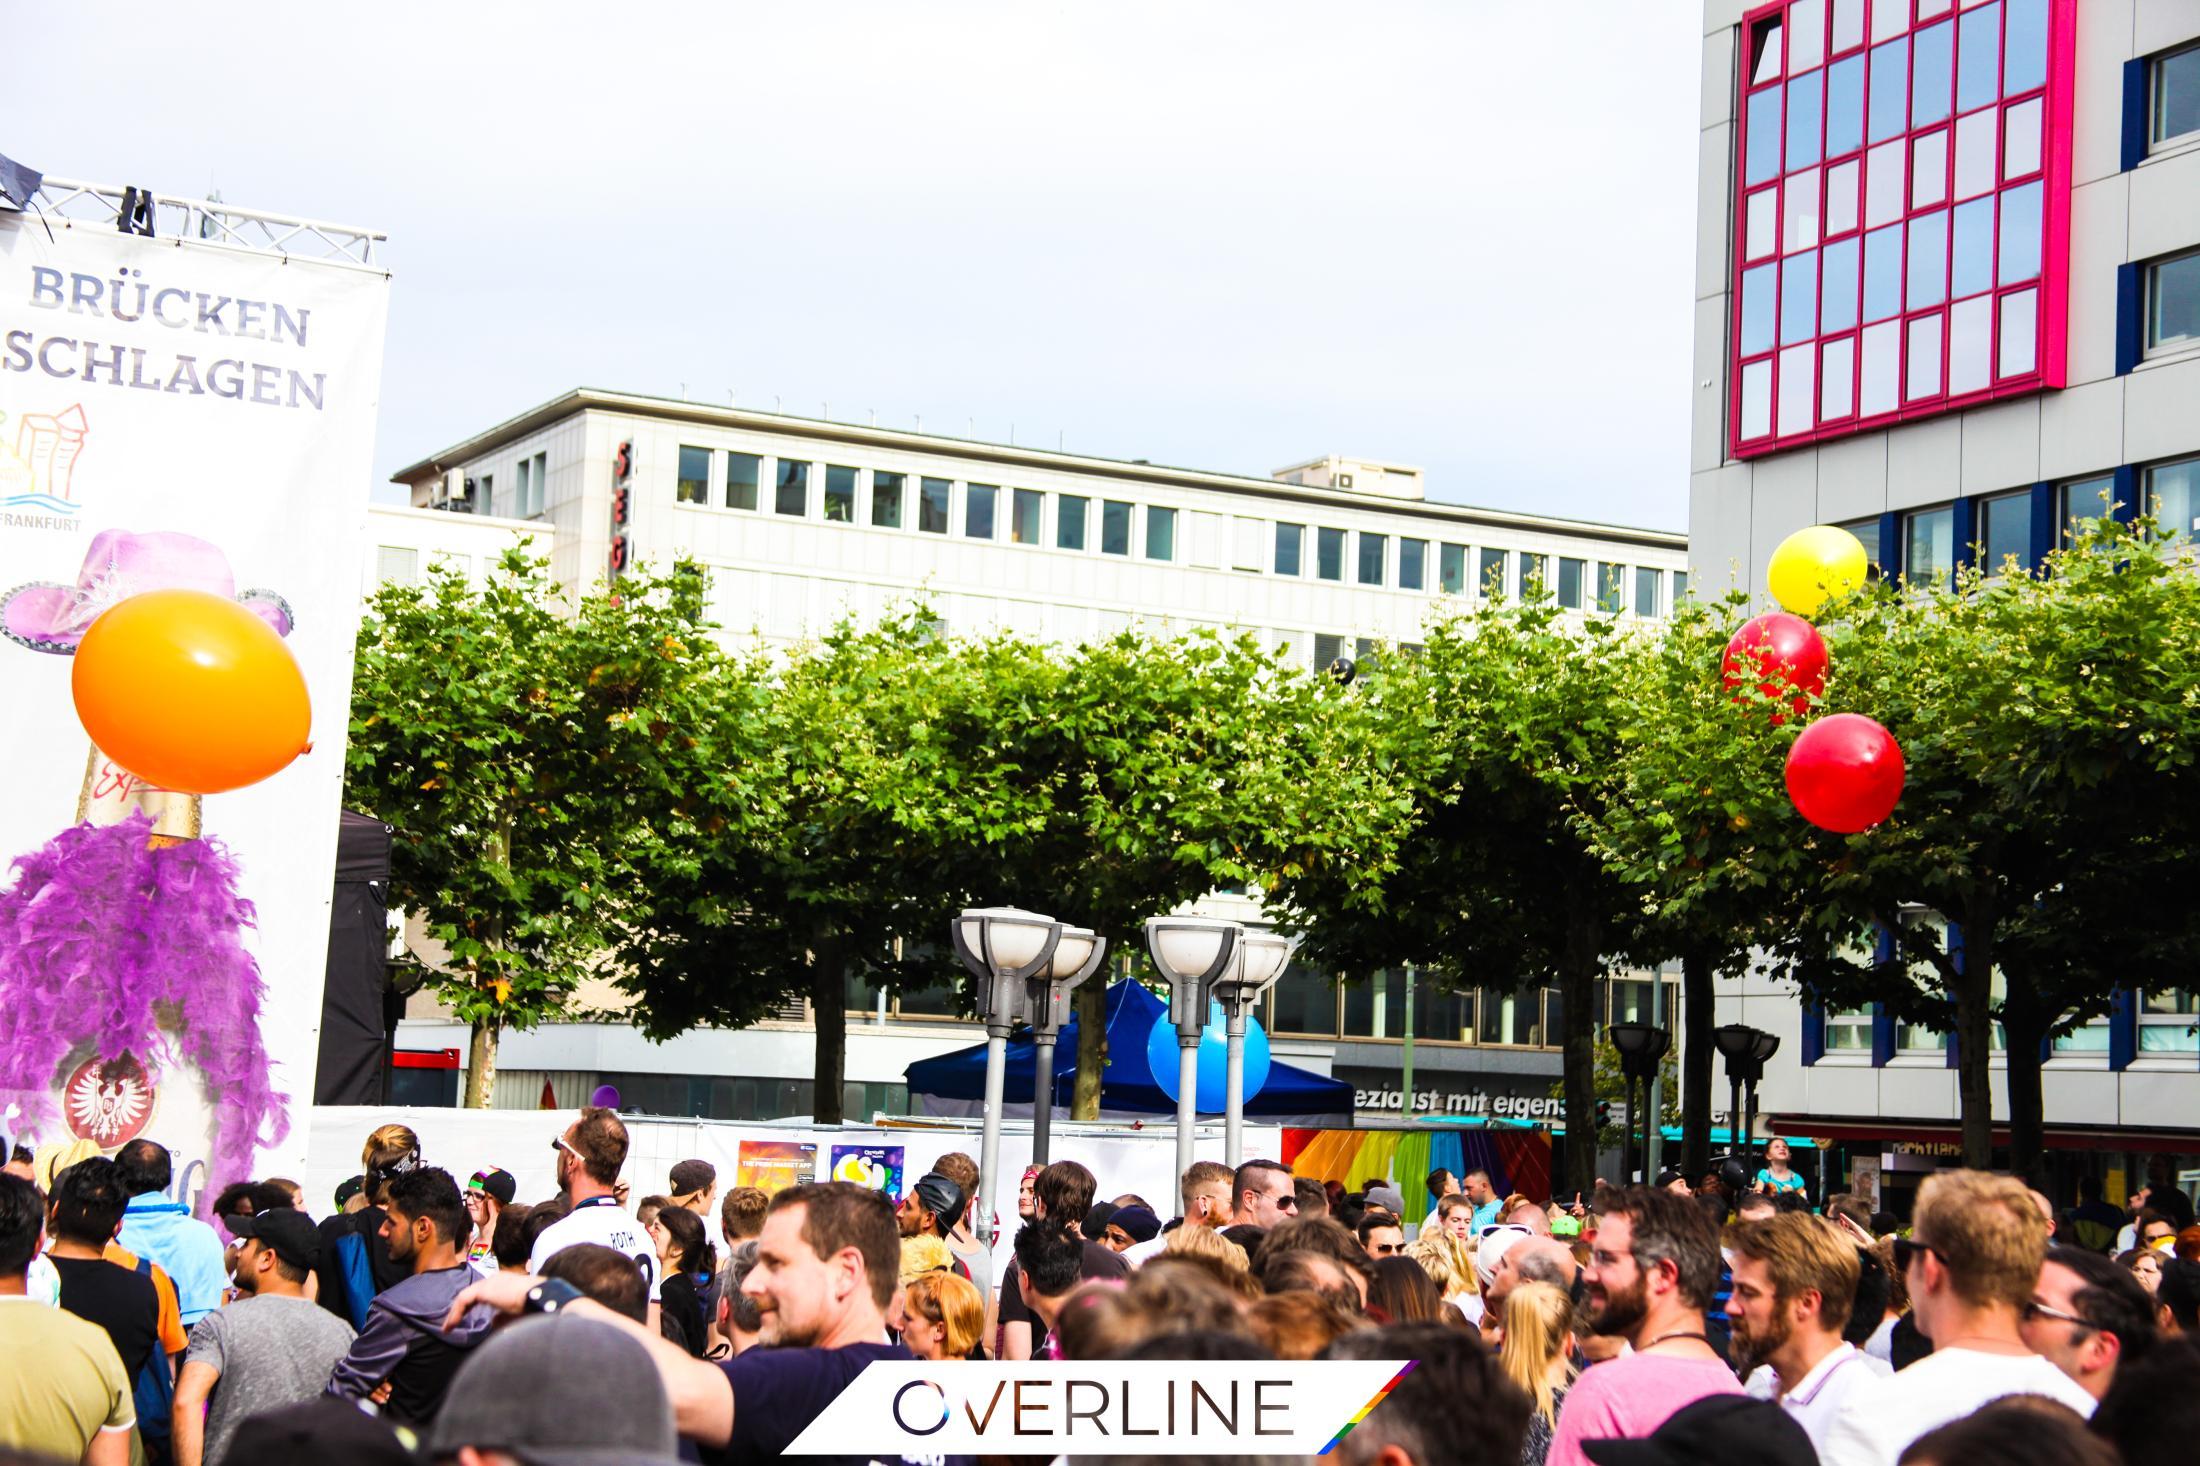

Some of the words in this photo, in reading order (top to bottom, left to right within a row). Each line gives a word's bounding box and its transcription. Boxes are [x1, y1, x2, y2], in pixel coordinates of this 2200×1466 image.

[28, 265, 311, 347] BRÜCKEN
[2, 329, 328, 411] SCHLAGEN
[1354, 1083, 1439, 1111] eziaist
[1446, 1086, 1489, 1113] mit
[610, 1231, 636, 1250] ROTH
